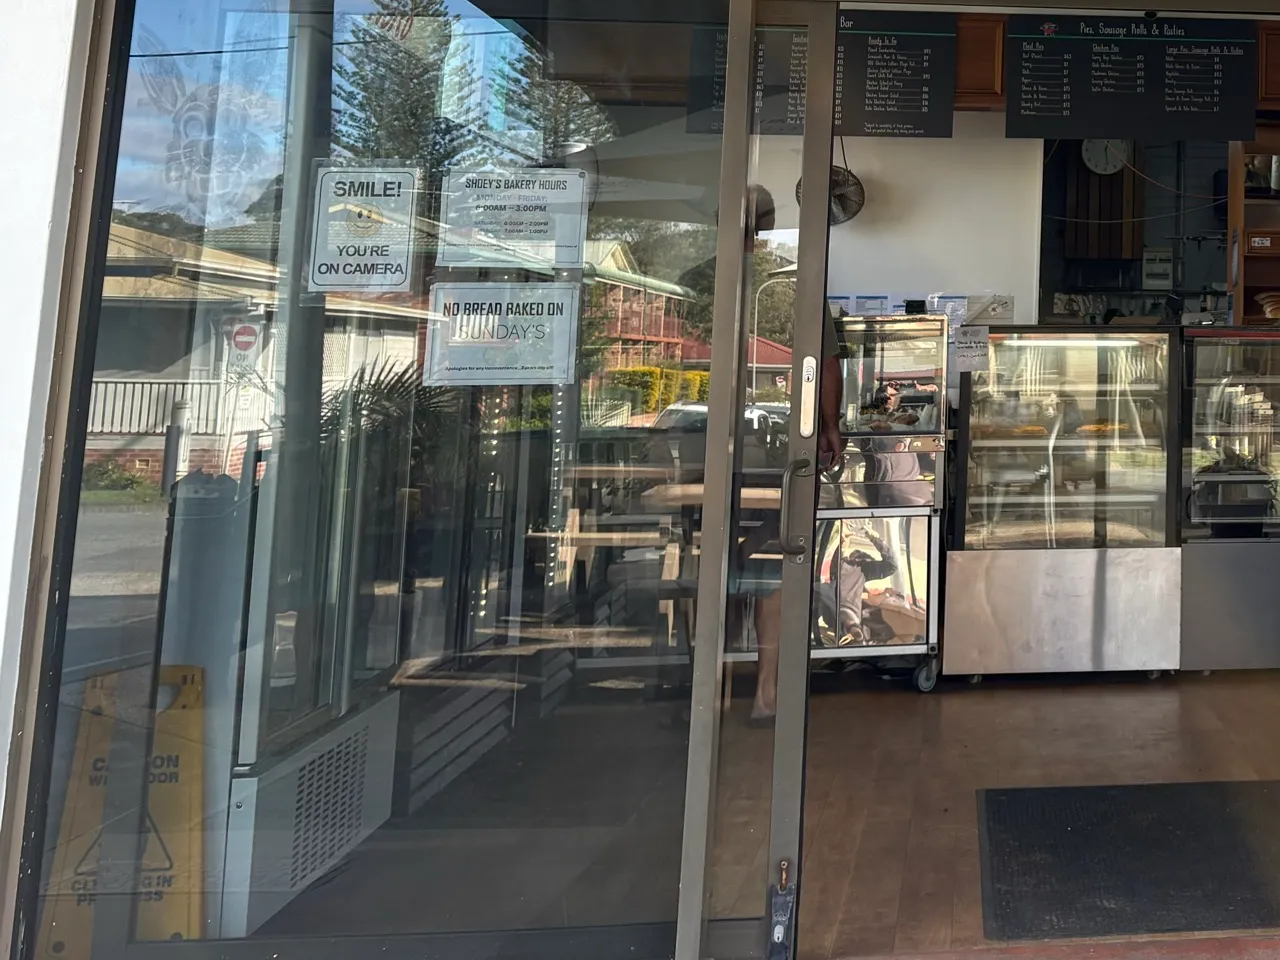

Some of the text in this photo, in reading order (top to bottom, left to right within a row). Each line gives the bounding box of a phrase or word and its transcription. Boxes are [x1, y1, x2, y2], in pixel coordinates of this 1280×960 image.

[840, 16, 854, 28] Bar
[1080, 22, 1185, 38] Pies, Sausage Rolls & Pasties
[333, 181, 402, 198] SMILE!
[465, 178, 568, 190] SHOEY'S BAKERY HOURS
[476, 194, 512, 202] MONDAY
[336, 245, 390, 257] YOU'RE
[318, 263, 404, 276] ON CAMERA
[443, 302, 564, 316] NO BREAD BAKED ON
[459, 324, 546, 340] SUNDAY'S
